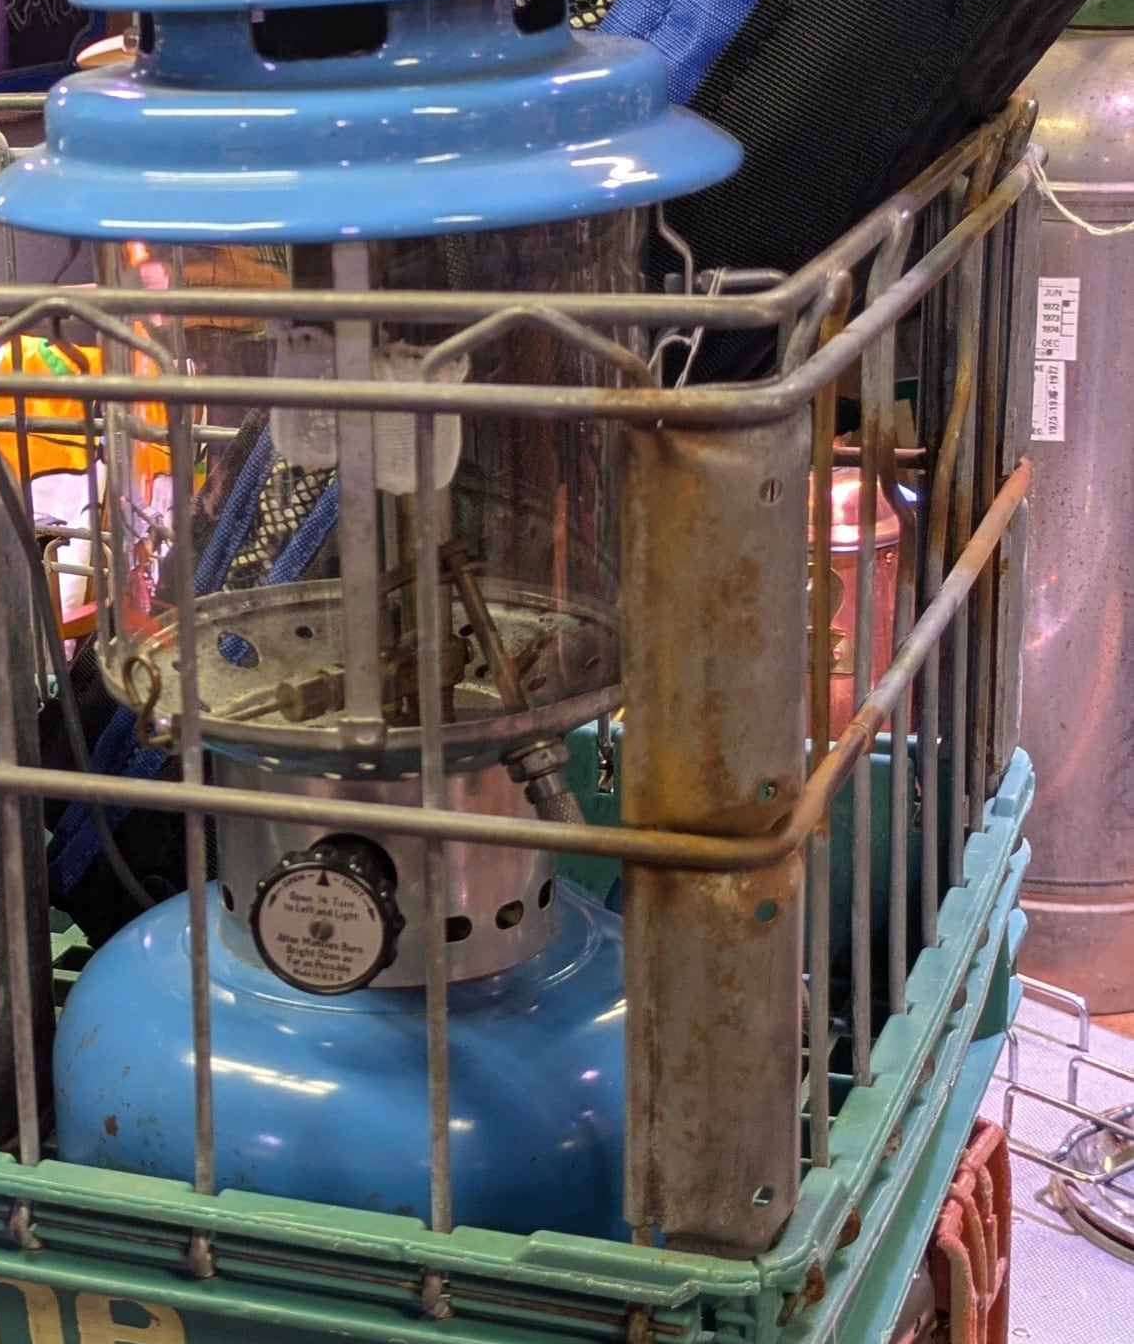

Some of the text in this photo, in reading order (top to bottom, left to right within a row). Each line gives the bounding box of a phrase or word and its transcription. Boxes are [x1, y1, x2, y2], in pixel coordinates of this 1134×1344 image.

[1043, 288, 1063, 297] JUN
[1042, 302, 1061, 312] 1972
[1041, 338, 1061, 348] DEC
